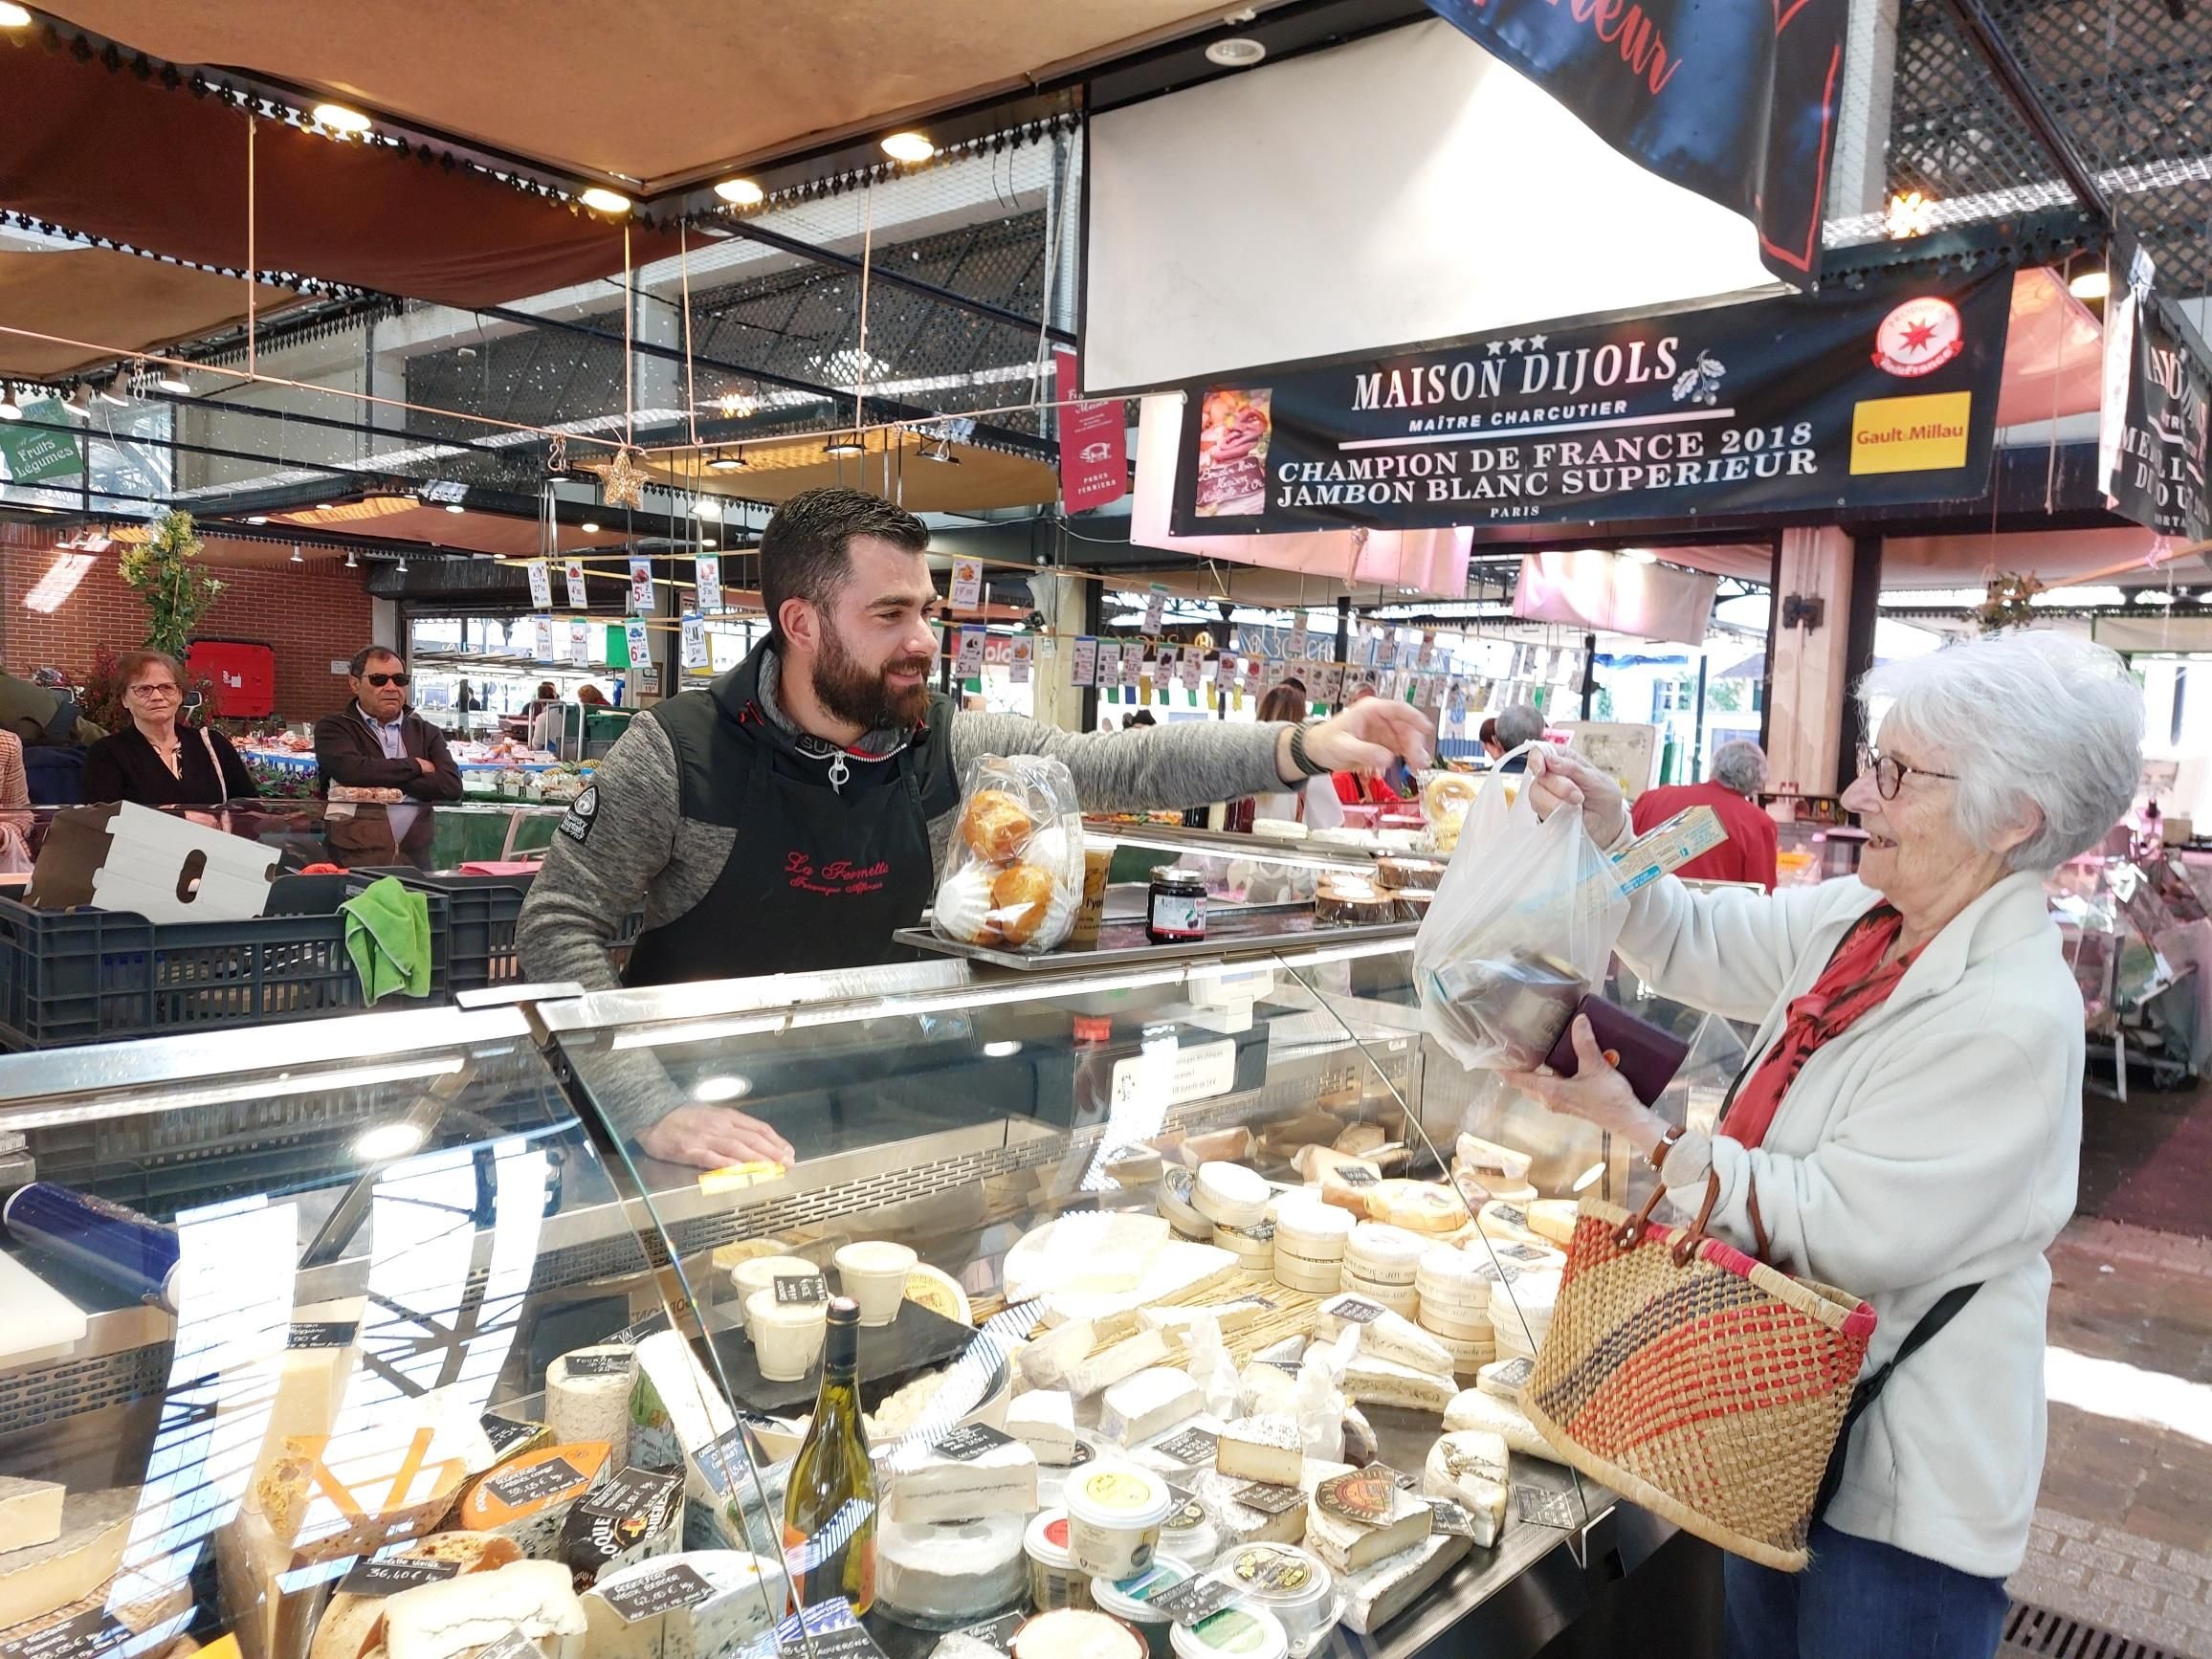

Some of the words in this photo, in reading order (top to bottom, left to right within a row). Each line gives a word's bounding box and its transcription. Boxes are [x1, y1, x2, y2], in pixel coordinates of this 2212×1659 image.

[1351, 358, 1507, 411] MAISON
[1519, 336, 1679, 395] DIJOLS
[1408, 414, 1482, 432] MAÎTRE
[1491, 399, 1627, 426] CHARCUTIER
[17, 438, 56, 462] Fruits
[1856, 427, 1903, 445] Gault
[1909, 423, 1964, 441] Millau
[1277, 451, 1458, 483] CHAMPION
[1470, 446, 1520, 474] DE
[1533, 431, 1704, 469] FRANCE
[1720, 421, 1813, 455] 2018
[1276, 480, 1416, 508] JAMBON
[1426, 471, 1549, 502] BLANC
[1561, 448, 1818, 496] SUPERIEUR
[1489, 505, 1540, 519] PARIS
